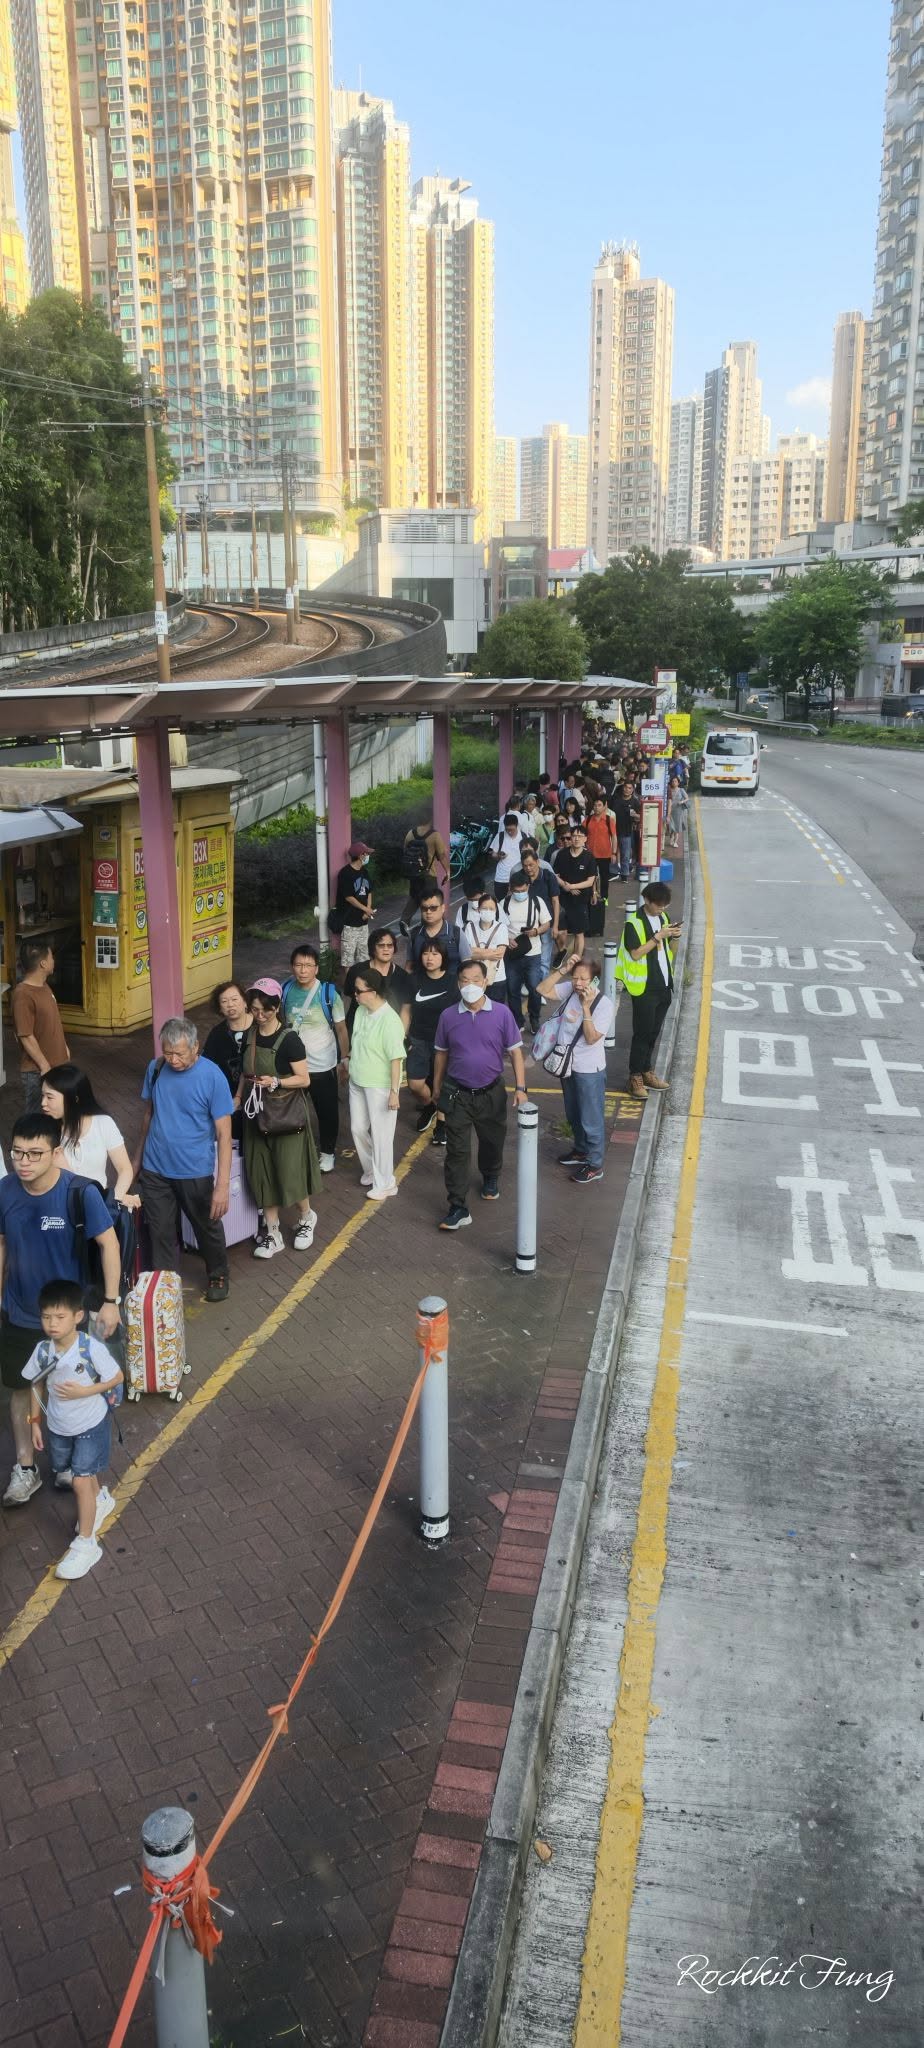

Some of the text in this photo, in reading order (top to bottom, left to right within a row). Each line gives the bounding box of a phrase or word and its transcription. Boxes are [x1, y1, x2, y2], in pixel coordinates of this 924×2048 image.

[645, 783, 660, 791] 56S
[193, 840, 208, 863] B3X
[728, 943, 866, 973] BUS
[711, 979, 905, 1019] STOP
[721, 1029, 924, 1118] 巴士
[775, 1142, 924, 1292] 站
